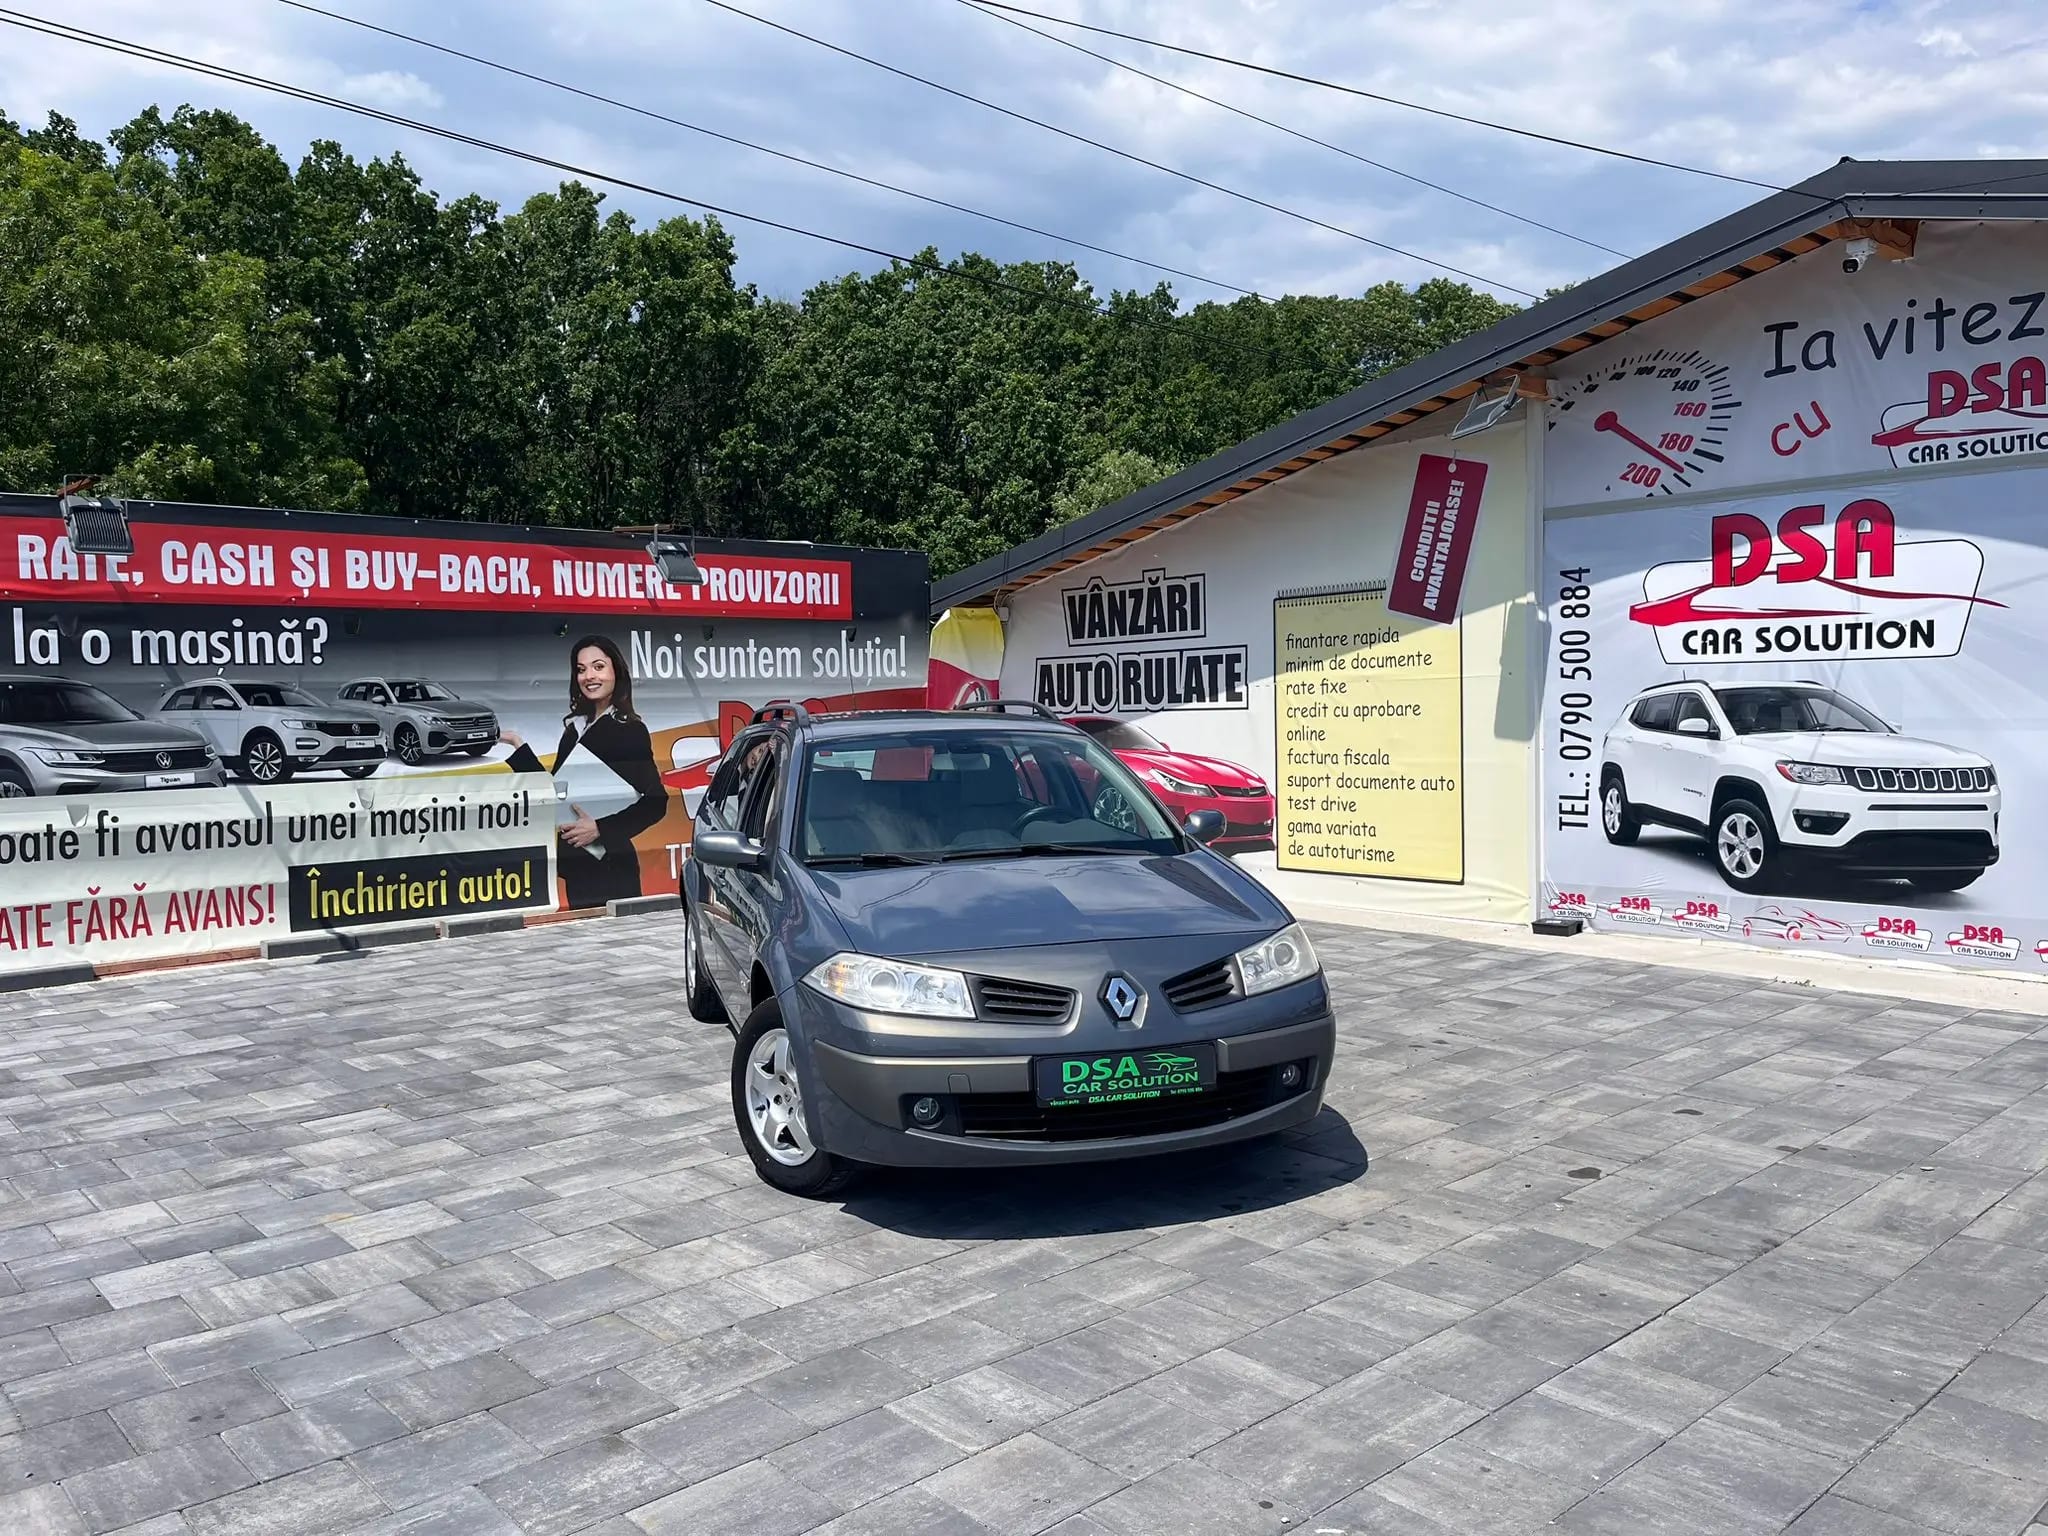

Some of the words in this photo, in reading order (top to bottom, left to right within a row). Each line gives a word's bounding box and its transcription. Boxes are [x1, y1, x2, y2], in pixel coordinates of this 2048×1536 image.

[1863, 291, 2046, 361] vitez
[1656, 367, 1682, 379] 120
[1671, 379, 1701, 392] 140
[1928, 356, 2047, 419] DSA
[1673, 402, 1707, 417] 160
[1771, 400, 1832, 456] cu
[1657, 432, 1694, 452] 180
[1908, 441, 1951, 464] CAR
[1619, 462, 1662, 488] 200
[1410, 500, 1441, 582] CONDITII
[1423, 479, 1465, 612] AVANTAJOASE!
[1712, 498, 1895, 588] DSA
[161, 540, 275, 587] CASH
[290, 546, 331, 598] ȘI
[345, 549, 541, 598] BUY-BACK,
[1559, 566, 1591, 619] 884
[1067, 576, 1201, 640] VÂNZĂRI
[80, 629, 111, 665] o
[131, 616, 329, 676] mașină?
[1285, 633, 1349, 651] finantare
[1353, 626, 1400, 650] rapida
[1682, 627, 1742, 656] CAR
[1755, 619, 1935, 654] SOLUTION
[630, 630, 683, 679] Noi
[695, 638, 801, 679] suntem
[812, 629, 906, 687] soluția!
[1286, 656, 1325, 673] minim
[1329, 654, 1347, 671] de
[1351, 650, 1433, 670] documente
[1559, 630, 1593, 681] 500
[1037, 660, 1113, 708] AUTO
[1122, 653, 1243, 706] RULATE
[1286, 680, 1316, 696] rate
[1320, 678, 1347, 695] fixe
[1286, 702, 1328, 719] credit
[1333, 705, 1349, 718] cu
[1353, 700, 1422, 722] aprobare
[1286, 725, 1327, 742] online
[1559, 692, 1593, 761] 0790
[1287, 748, 1339, 765] factura
[1343, 748, 1390, 766] fiscala
[1287, 773, 1331, 792] suport
[1336, 772, 1416, 791] documente
[1420, 775, 1456, 792] auto
[1287, 795, 1316, 811] test
[1320, 795, 1357, 813] drive
[1558, 771, 1591, 832] TEL.:
[95, 809, 120, 857] fi
[136, 801, 274, 854] avansul
[288, 801, 356, 843] unei
[370, 795, 466, 843] mașini
[478, 790, 529, 830] noi!
[1287, 821, 1322, 838] gama
[1326, 820, 1377, 838] variata
[1288, 840, 1305, 856] de
[1308, 843, 1396, 863] autoturisme
[306, 866, 448, 919] Închirieri
[458, 860, 531, 905] auto!
[1558, 892, 1587, 906] DSA
[67, 881, 153, 945] FĂRĂ
[164, 883, 276, 935] AVANS!
[1620, 896, 1651, 911] DSA
[1686, 901, 1719, 918] DSA
[1878, 916, 1916, 935] DSA
[1963, 924, 2003, 944] DSA
[1886, 939, 1923, 950] SOLUTION
[1973, 948, 2011, 959] SOLUTION
[1062, 1056, 1141, 1083] DSA
[1063, 1082, 1103, 1094] CAR
[1108, 1071, 1199, 1091] SOLUTION
[1088, 1096, 1106, 1104] DSA
[1106, 1094, 1122, 1102] CAR
[1123, 1090, 1160, 1101] SOLUTION
